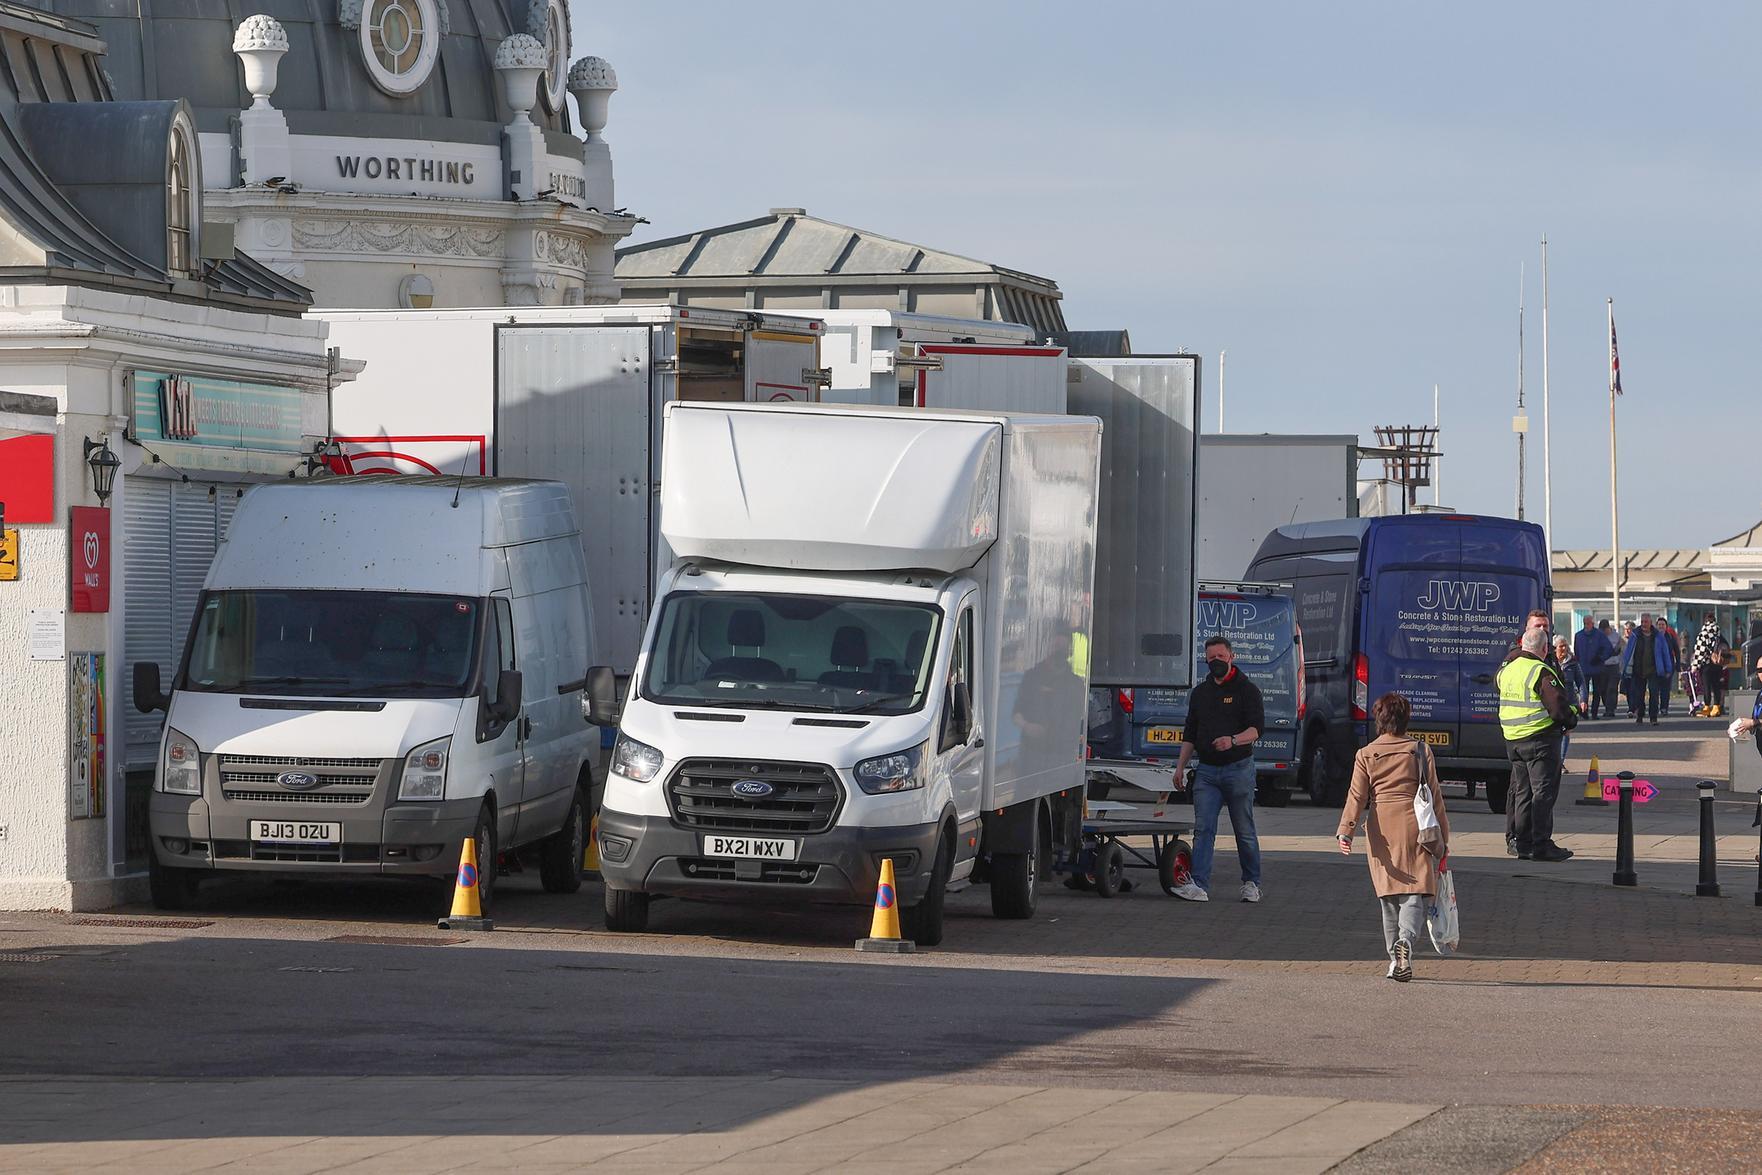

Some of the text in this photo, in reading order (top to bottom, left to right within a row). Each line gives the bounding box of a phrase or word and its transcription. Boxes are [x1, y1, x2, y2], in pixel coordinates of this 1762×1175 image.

[336, 156, 474, 185] WORTHING
[1417, 580, 1501, 612] JWP
[1197, 601, 1257, 629] WP
[1398, 611, 1431, 620] Concrete
[1433, 612, 1439, 620] &
[1465, 613, 1506, 623] Restoration
[1508, 615, 1520, 624] Ltd
[1224, 630, 1263, 640] Restoration
[1264, 633, 1275, 641] Ltd
[1428, 646, 1440, 654] Tel:
[1442, 646, 1463, 654] 01243
[1153, 731, 1177, 742] HL21
[1428, 734, 1448, 744] SVD
[286, 775, 308, 784] Ford
[741, 783, 763, 793] Ford
[1604, 785, 1648, 797] CATING
[260, 823, 329, 839] BJ13 OZU
[713, 838, 785, 857] BX21 WXV
